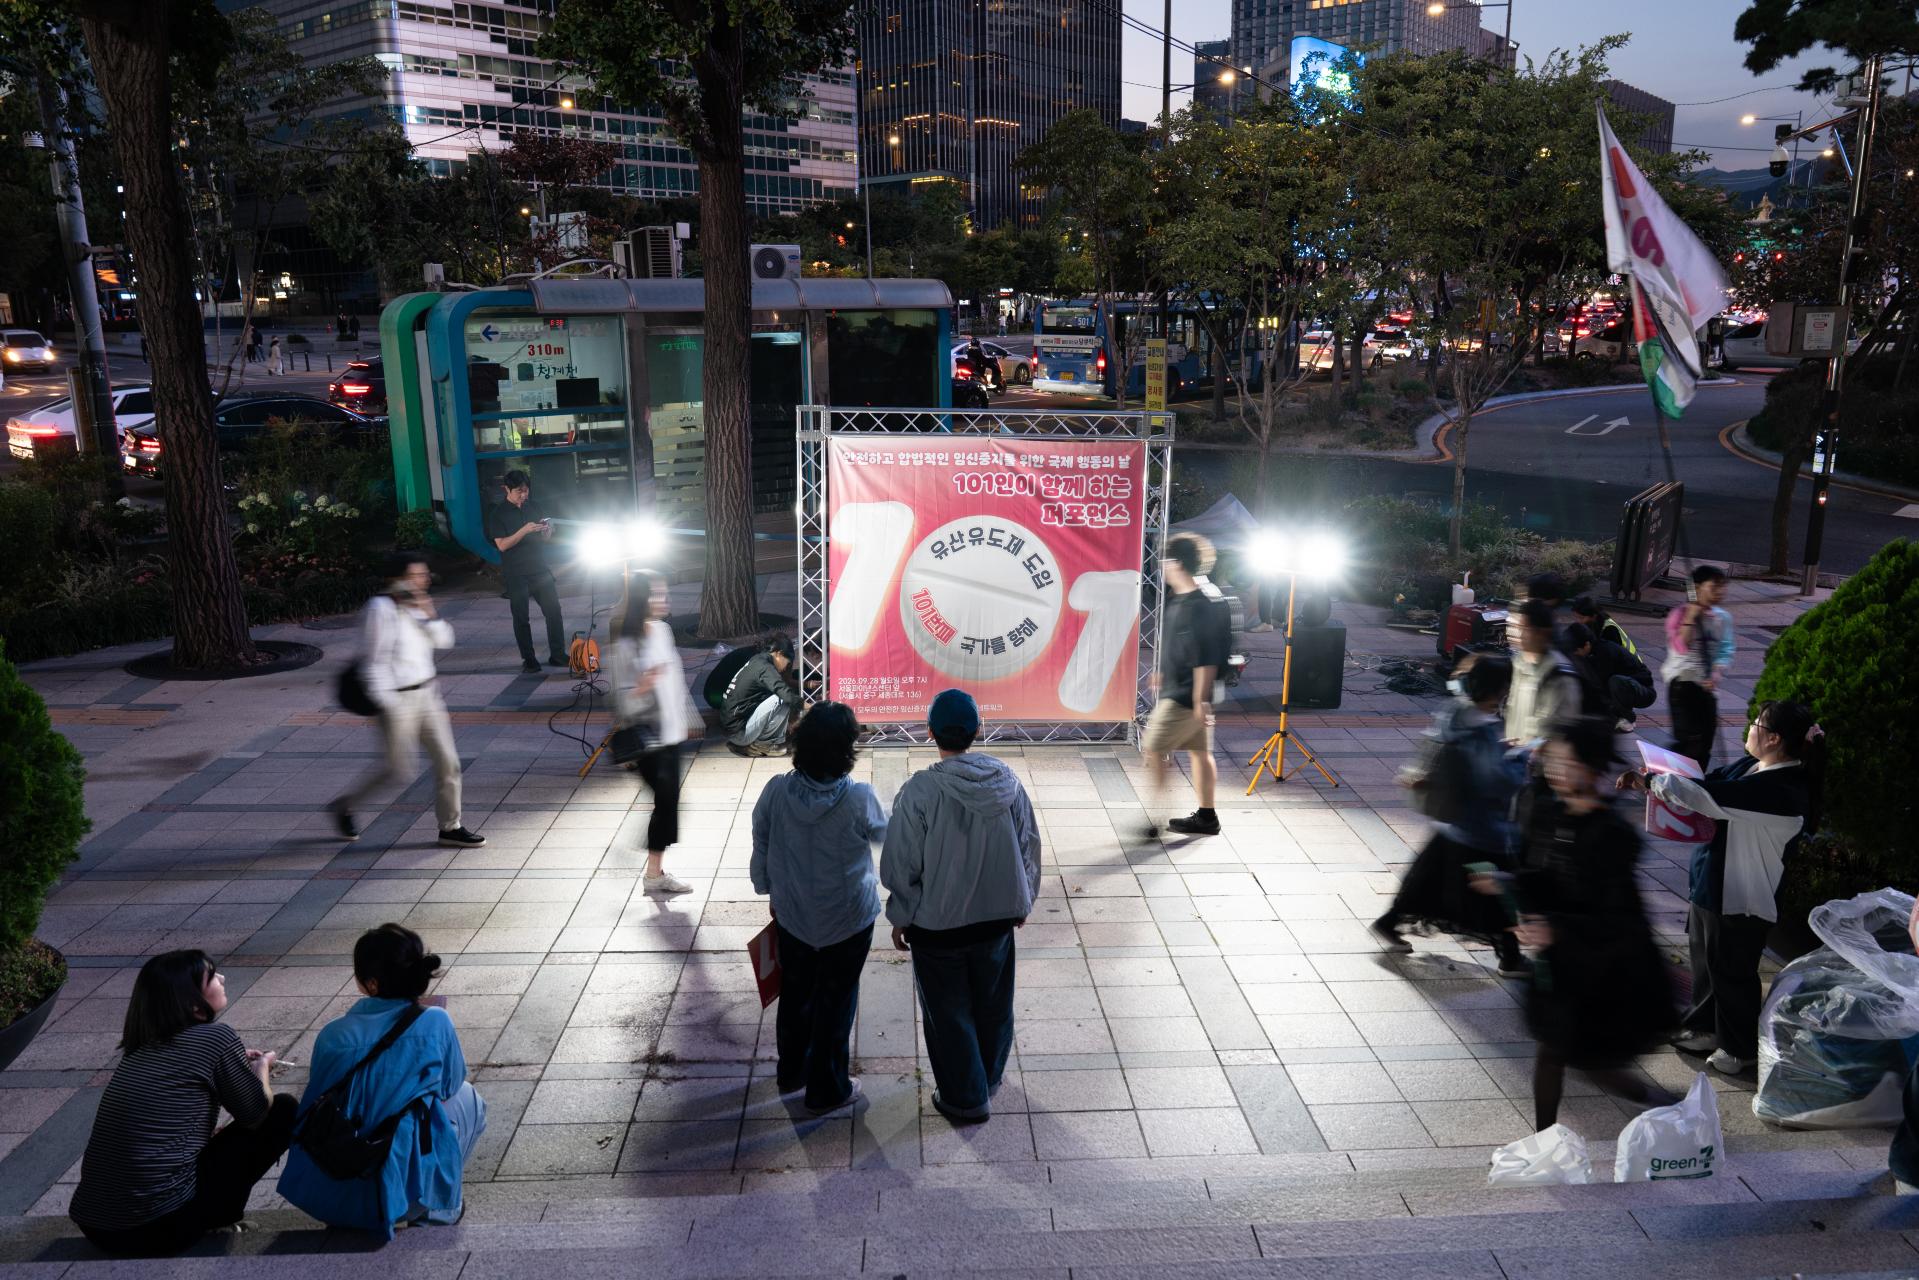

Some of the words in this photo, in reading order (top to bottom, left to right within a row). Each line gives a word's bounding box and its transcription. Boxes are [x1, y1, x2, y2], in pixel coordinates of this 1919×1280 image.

[1078, 318, 1089, 326] 501
[528, 343, 564, 356] 310m
[842, 451, 895, 466] 안전하고
[898, 451, 949, 466] 합법적인
[953, 452, 1016, 467] 임신중지를
[1020, 454, 1045, 468] 위한
[1048, 455, 1074, 469] 국제
[1077, 455, 1115, 469] 행동의
[1118, 455, 1131, 469] 날
[953, 471, 1036, 497] 101인이
[1040, 474, 1086, 499] 함께
[1088, 474, 1132, 499] 하는
[1041, 502, 1130, 529] 퍼포먼스
[930, 526, 1026, 560] 유산유도제
[1022, 552, 1054, 590] 도입
[911, 587, 958, 647] 101번째
[960, 635, 1007, 656] 국가를
[1006, 617, 1039, 648] 향해
[838, 677, 879, 685] 2026.09.28
[880, 676, 900, 685] 월요일
[901, 676, 914, 684] 오후
[906, 690, 922, 699] 136)
[1650, 1156, 1697, 1172] green
